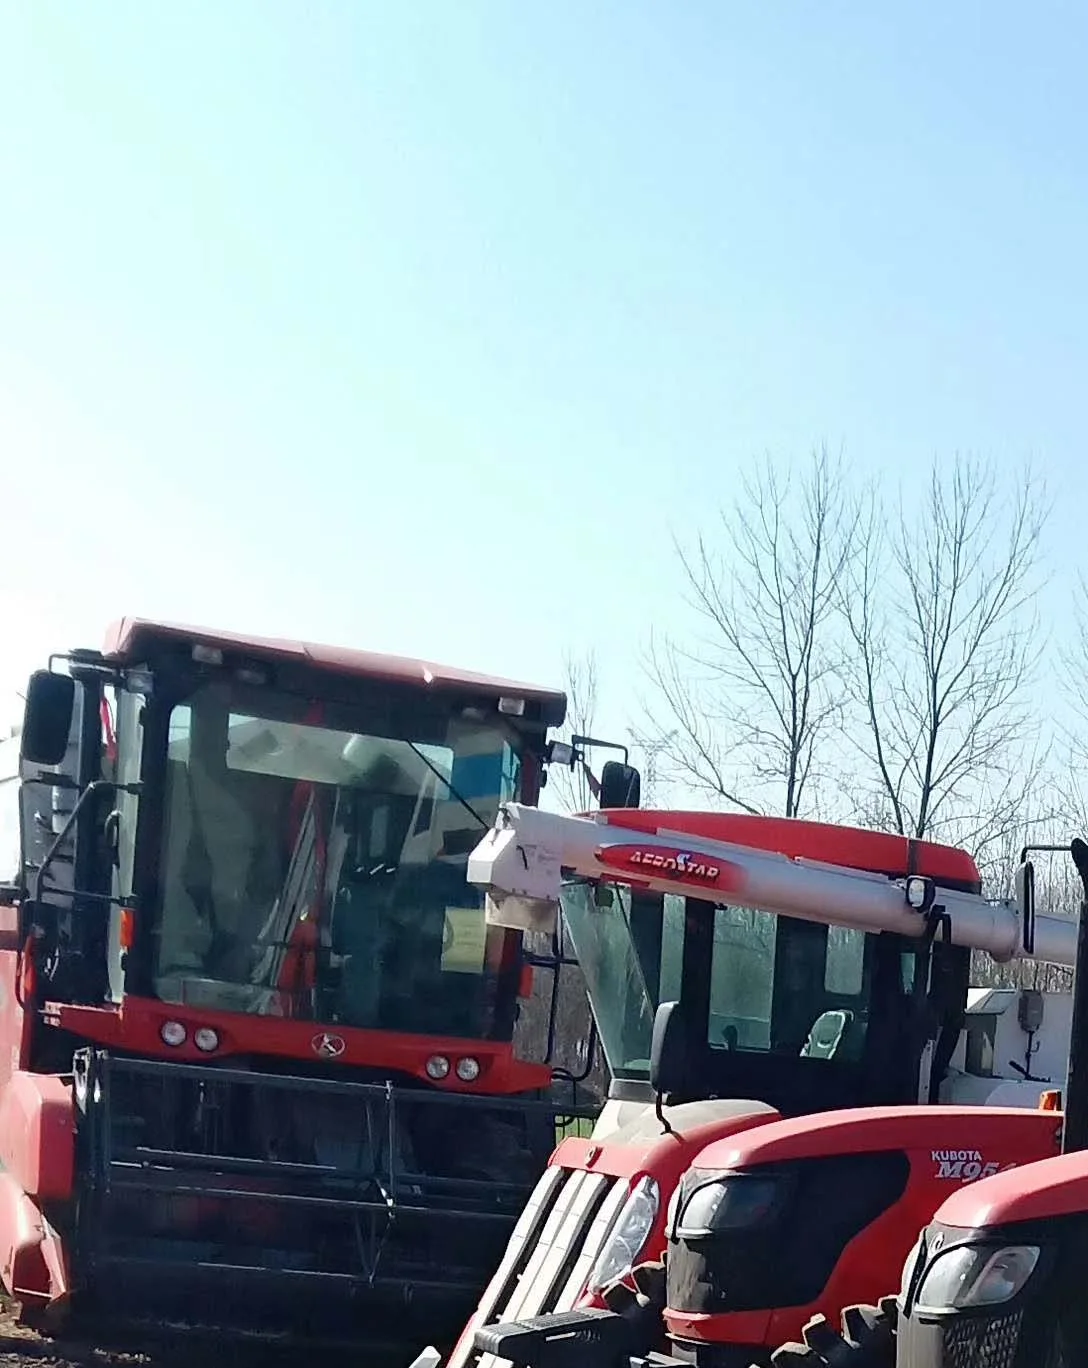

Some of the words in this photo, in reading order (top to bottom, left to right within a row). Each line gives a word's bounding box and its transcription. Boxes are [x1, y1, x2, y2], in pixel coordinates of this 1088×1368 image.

[630, 851, 720, 878] AEROSTAR
[931, 1150, 983, 1161] KUBOTA
[934, 1161, 1017, 1183] M95
